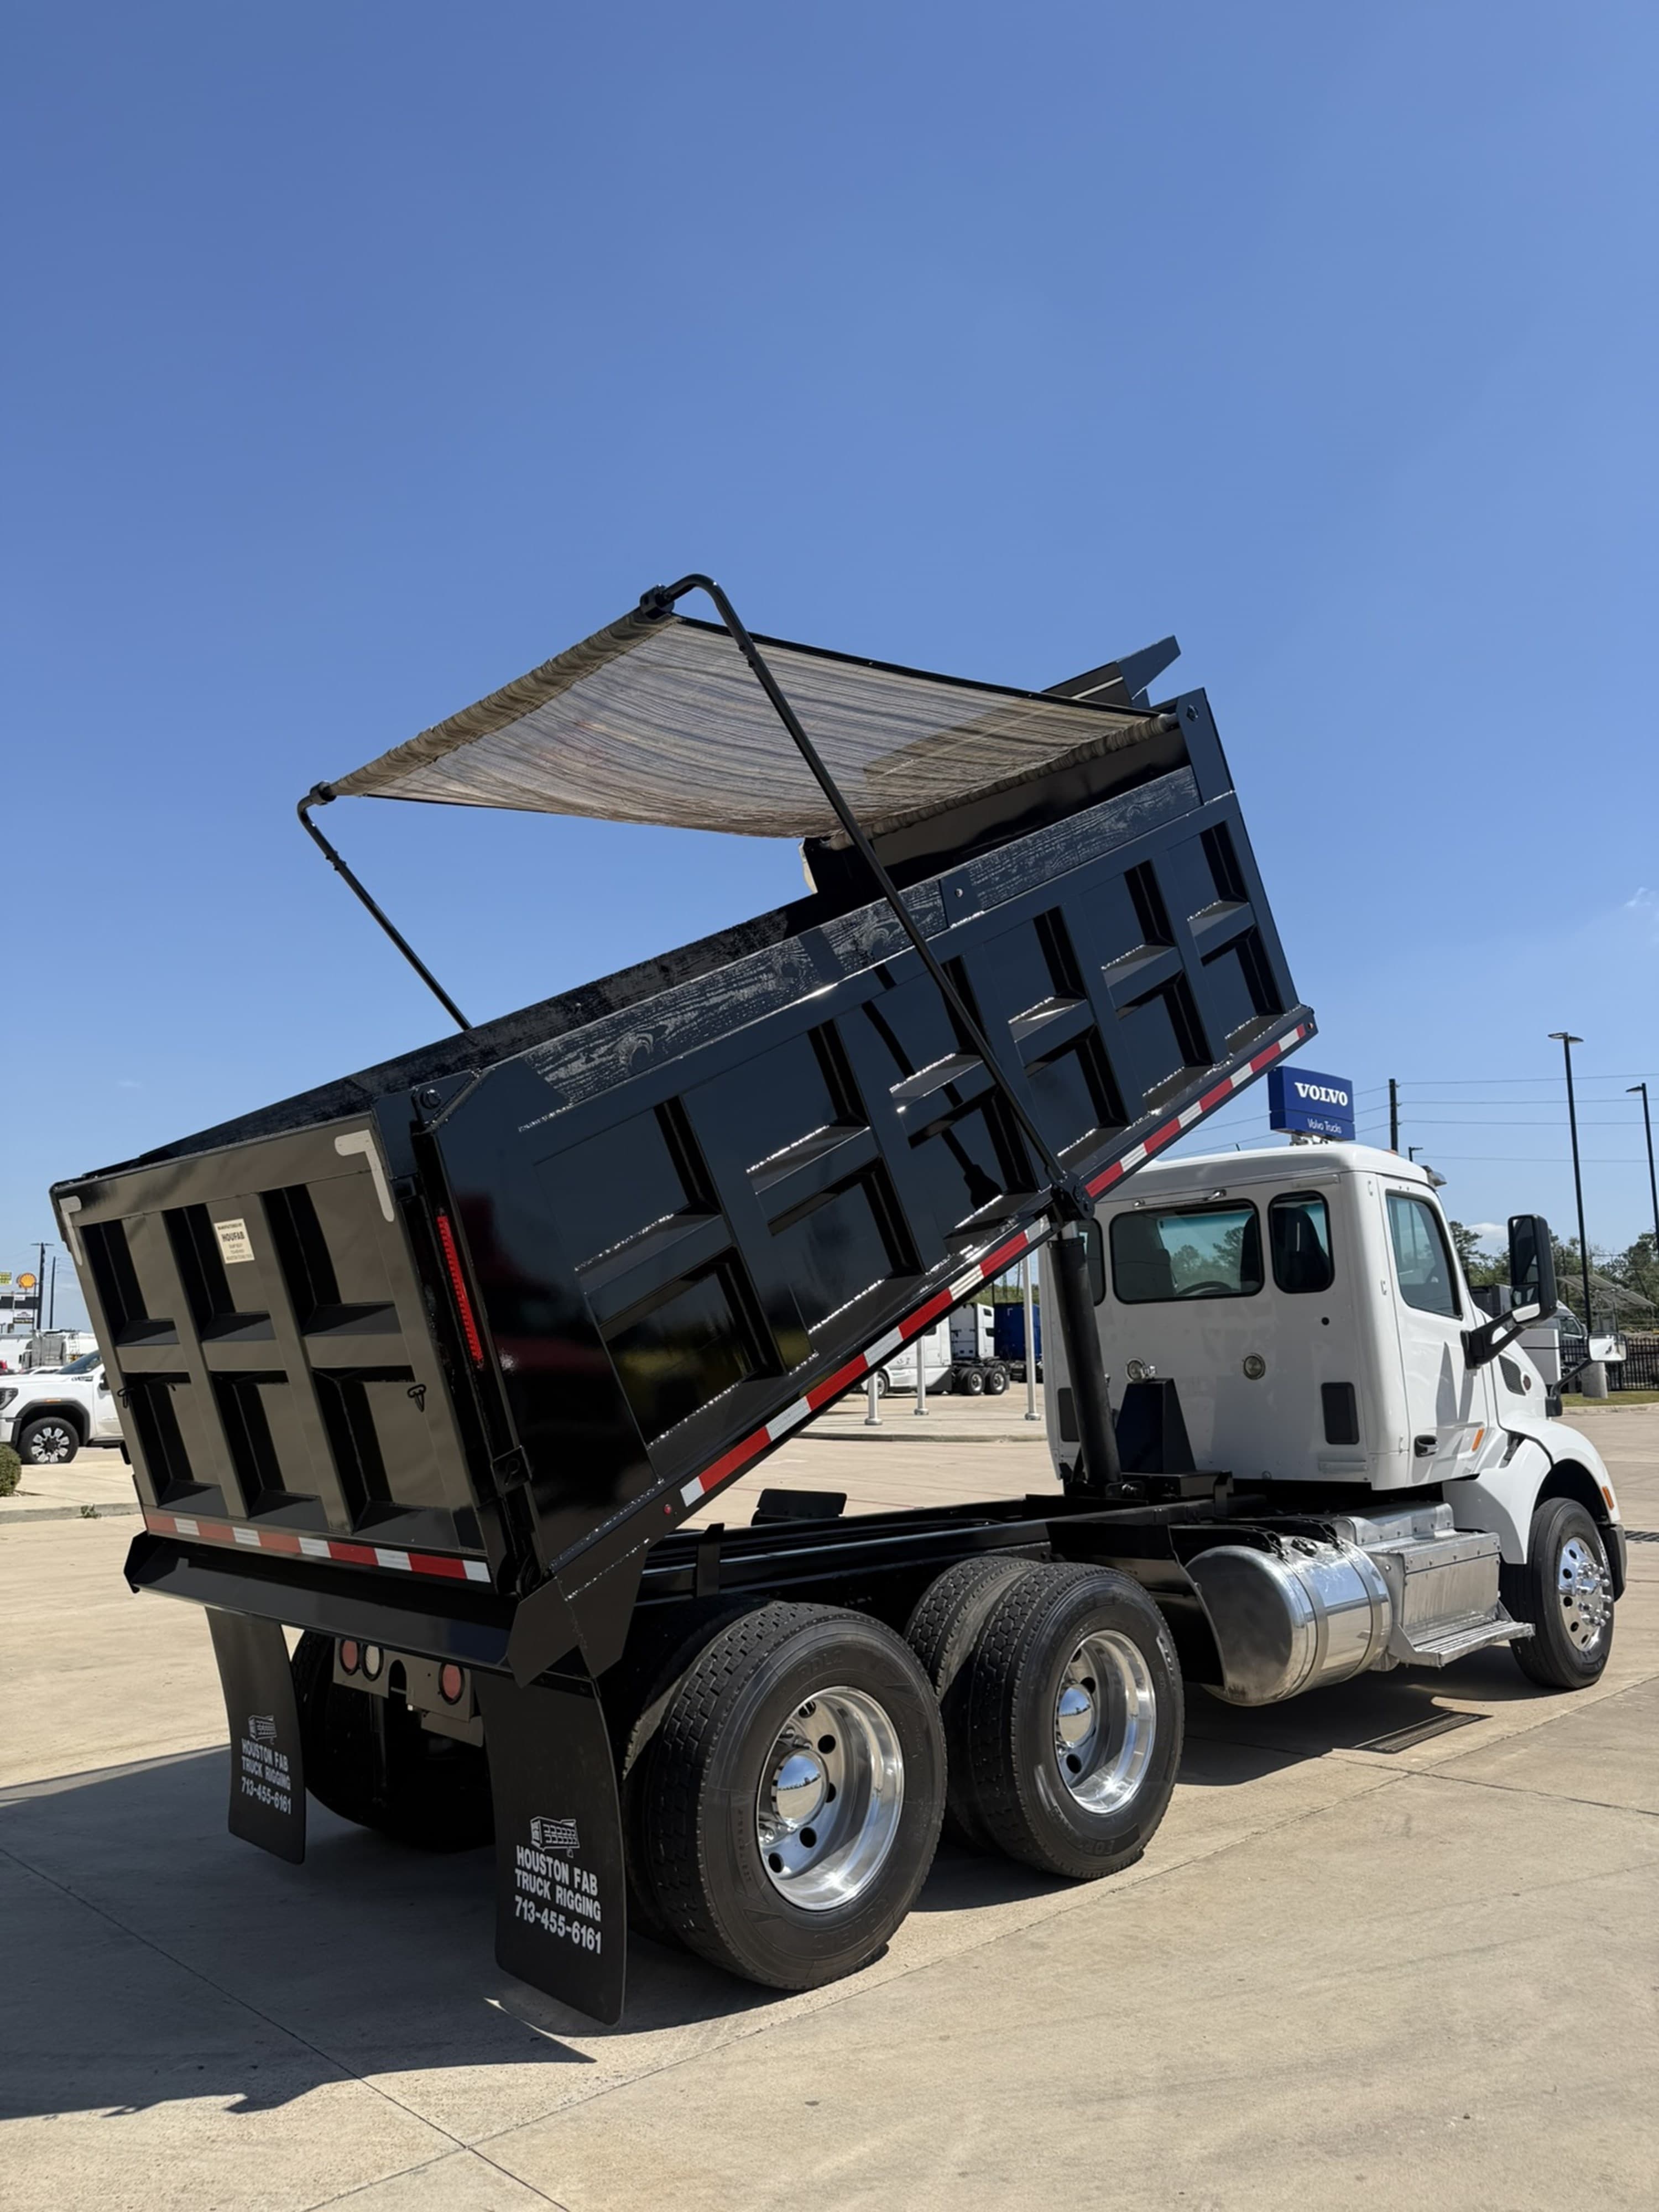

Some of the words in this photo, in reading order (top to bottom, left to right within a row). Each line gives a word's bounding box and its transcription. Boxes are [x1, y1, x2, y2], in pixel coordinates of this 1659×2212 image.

[1295, 1082, 1348, 1106] VOLVO
[1307, 1118, 1324, 1130] Volvo
[1324, 1121, 1342, 1134] Trucks
[242, 1738, 273, 1766] HOUSTON
[274, 1751, 288, 1772] FAB
[242, 1756, 263, 1778] TRUCK
[265, 1765, 291, 1791] RIGGING
[242, 1776, 291, 1814] 713-455-6161
[517, 1845, 569, 1885] HOUSTON
[574, 1867, 598, 1896] FAB
[515, 1868, 551, 1900] TRUCK
[556, 1885, 601, 1922] RIGGING
[515, 1895, 601, 1954] 713-455-6161
